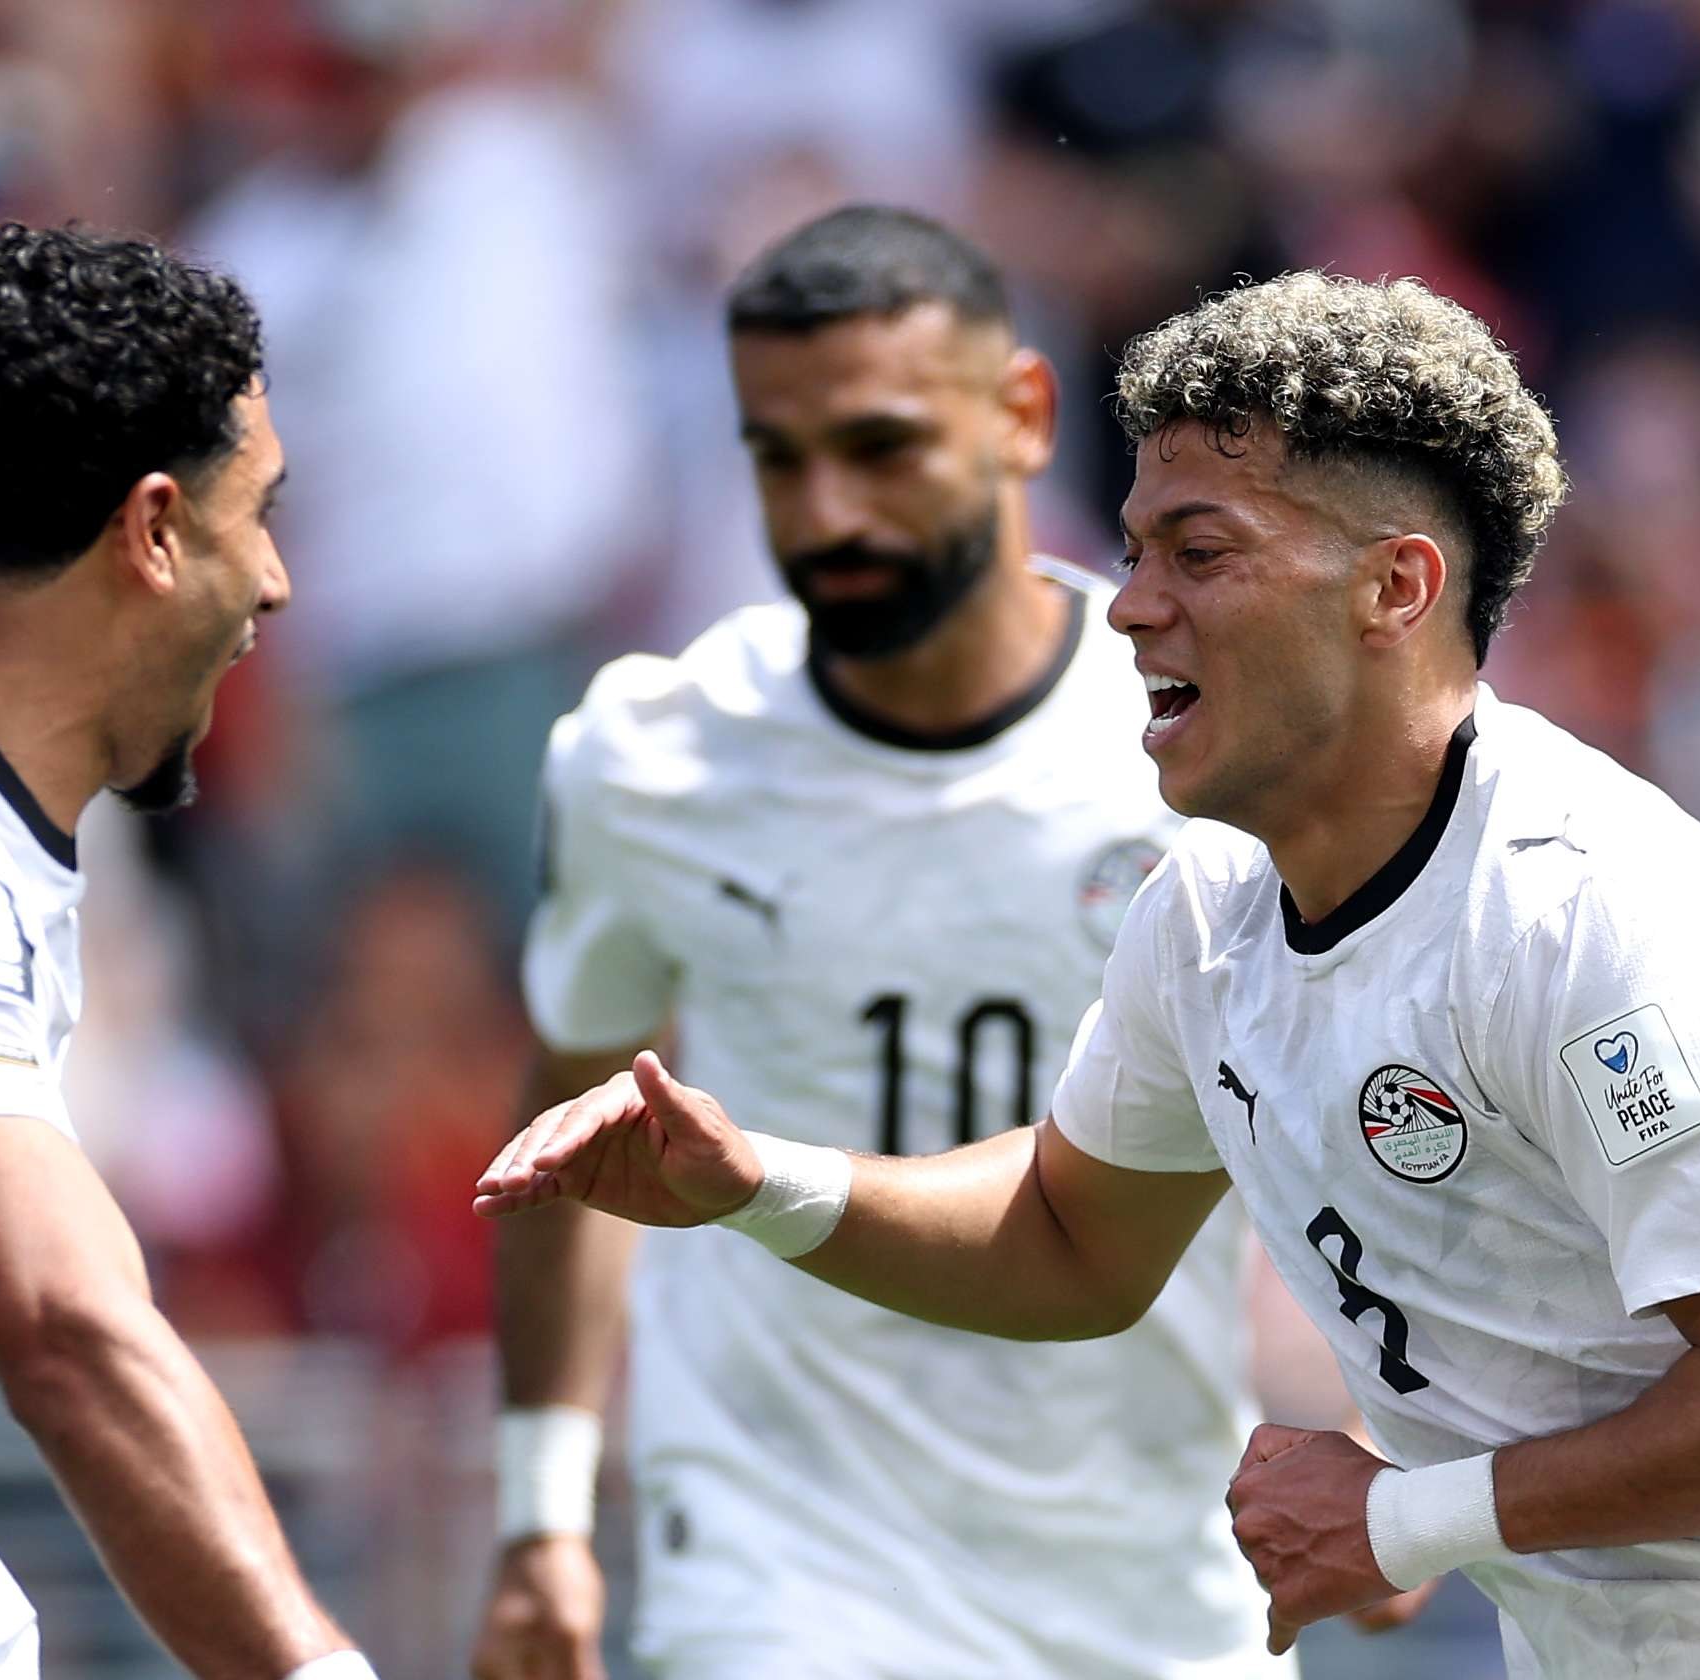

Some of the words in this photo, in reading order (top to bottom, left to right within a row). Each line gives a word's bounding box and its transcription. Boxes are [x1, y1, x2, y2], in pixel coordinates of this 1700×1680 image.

[859, 993, 1039, 1155] 10
[1604, 1079, 1642, 1109] Unite
[1639, 1065, 1664, 1091] For
[1617, 1088, 1675, 1132] PEACE
[1638, 1120, 1670, 1141] FIFA
[1401, 1159, 1440, 1172] EGYPTIAN
[1439, 1153, 1449, 1164] FA
